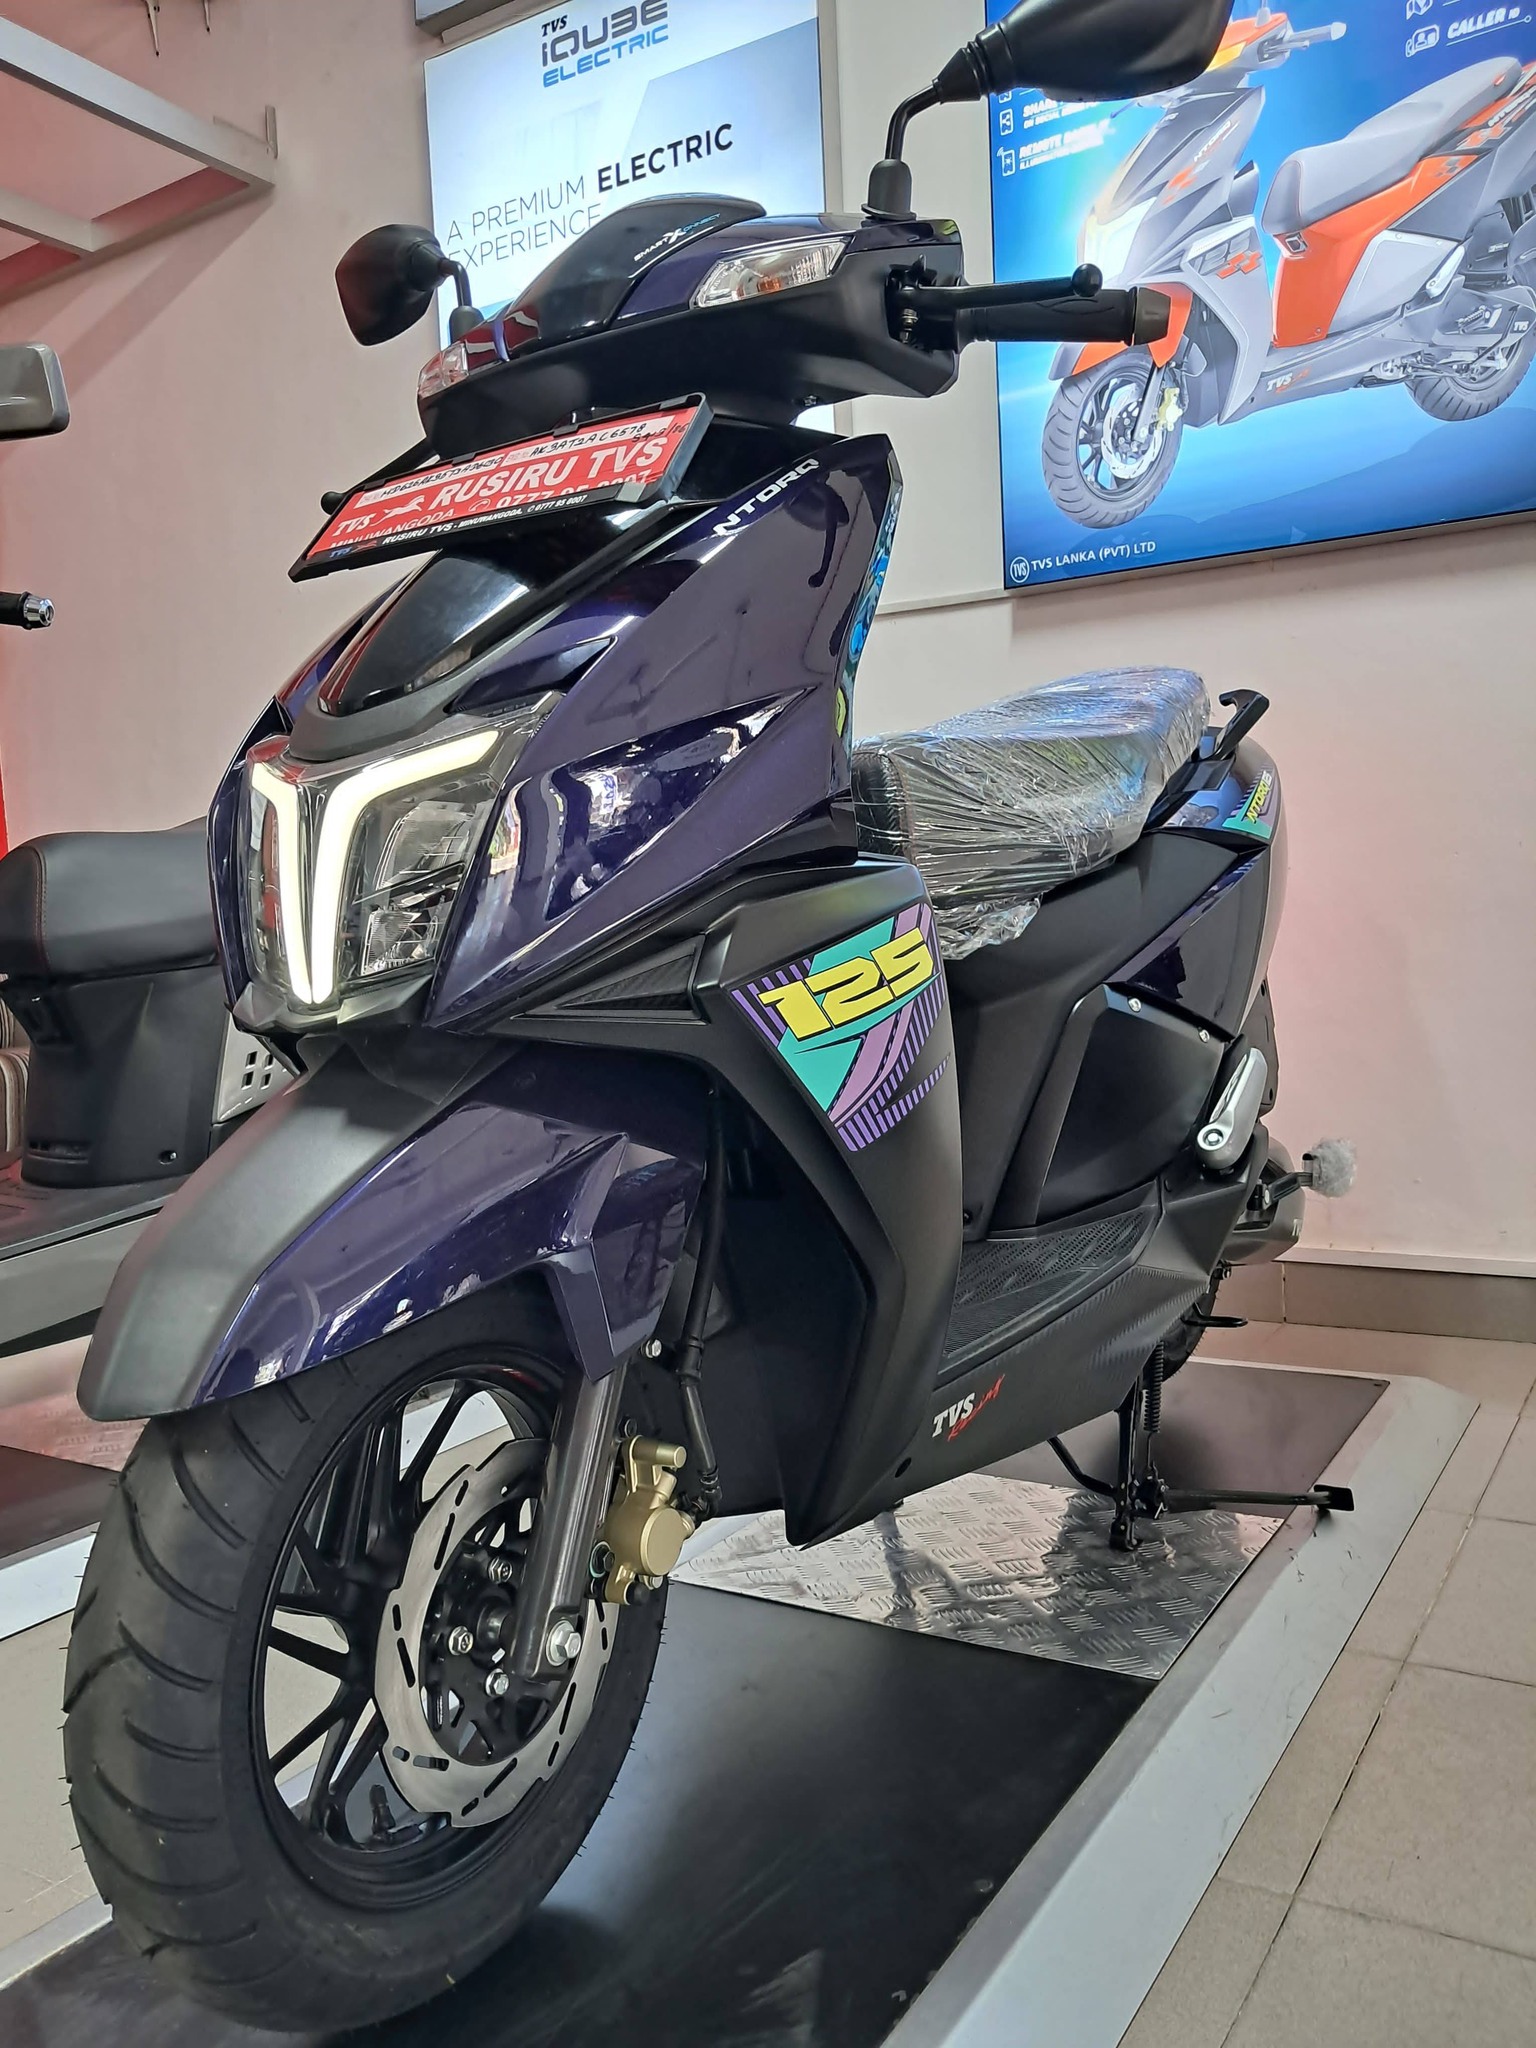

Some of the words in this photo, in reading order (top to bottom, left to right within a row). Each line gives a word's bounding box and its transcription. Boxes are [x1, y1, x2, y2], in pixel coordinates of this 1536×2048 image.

[541, 15, 568, 37] TVS
[1447, 8, 1507, 39] CALLER
[543, 24, 669, 88] ELECTRIC
[447, 220, 463, 246] A
[472, 175, 585, 236] PREMIUM
[597, 123, 733, 193] ELECTRIC
[1266, 373, 1293, 392] TVS
[332, 513, 377, 537] TVS
[428, 455, 579, 510] RUSIRU
[588, 436, 668, 479] TVS
[713, 458, 819, 536] NTORQ
[382, 529, 427, 545] RUSIRU
[430, 522, 454, 535] TVS
[1031, 557, 1052, 571] TVS
[1056, 551, 1096, 567] LANKA
[1099, 544, 1130, 561] (PVT)
[1134, 541, 1156, 554] LTD
[757, 927, 934, 1040] 125
[932, 1392, 976, 1438] TVS
